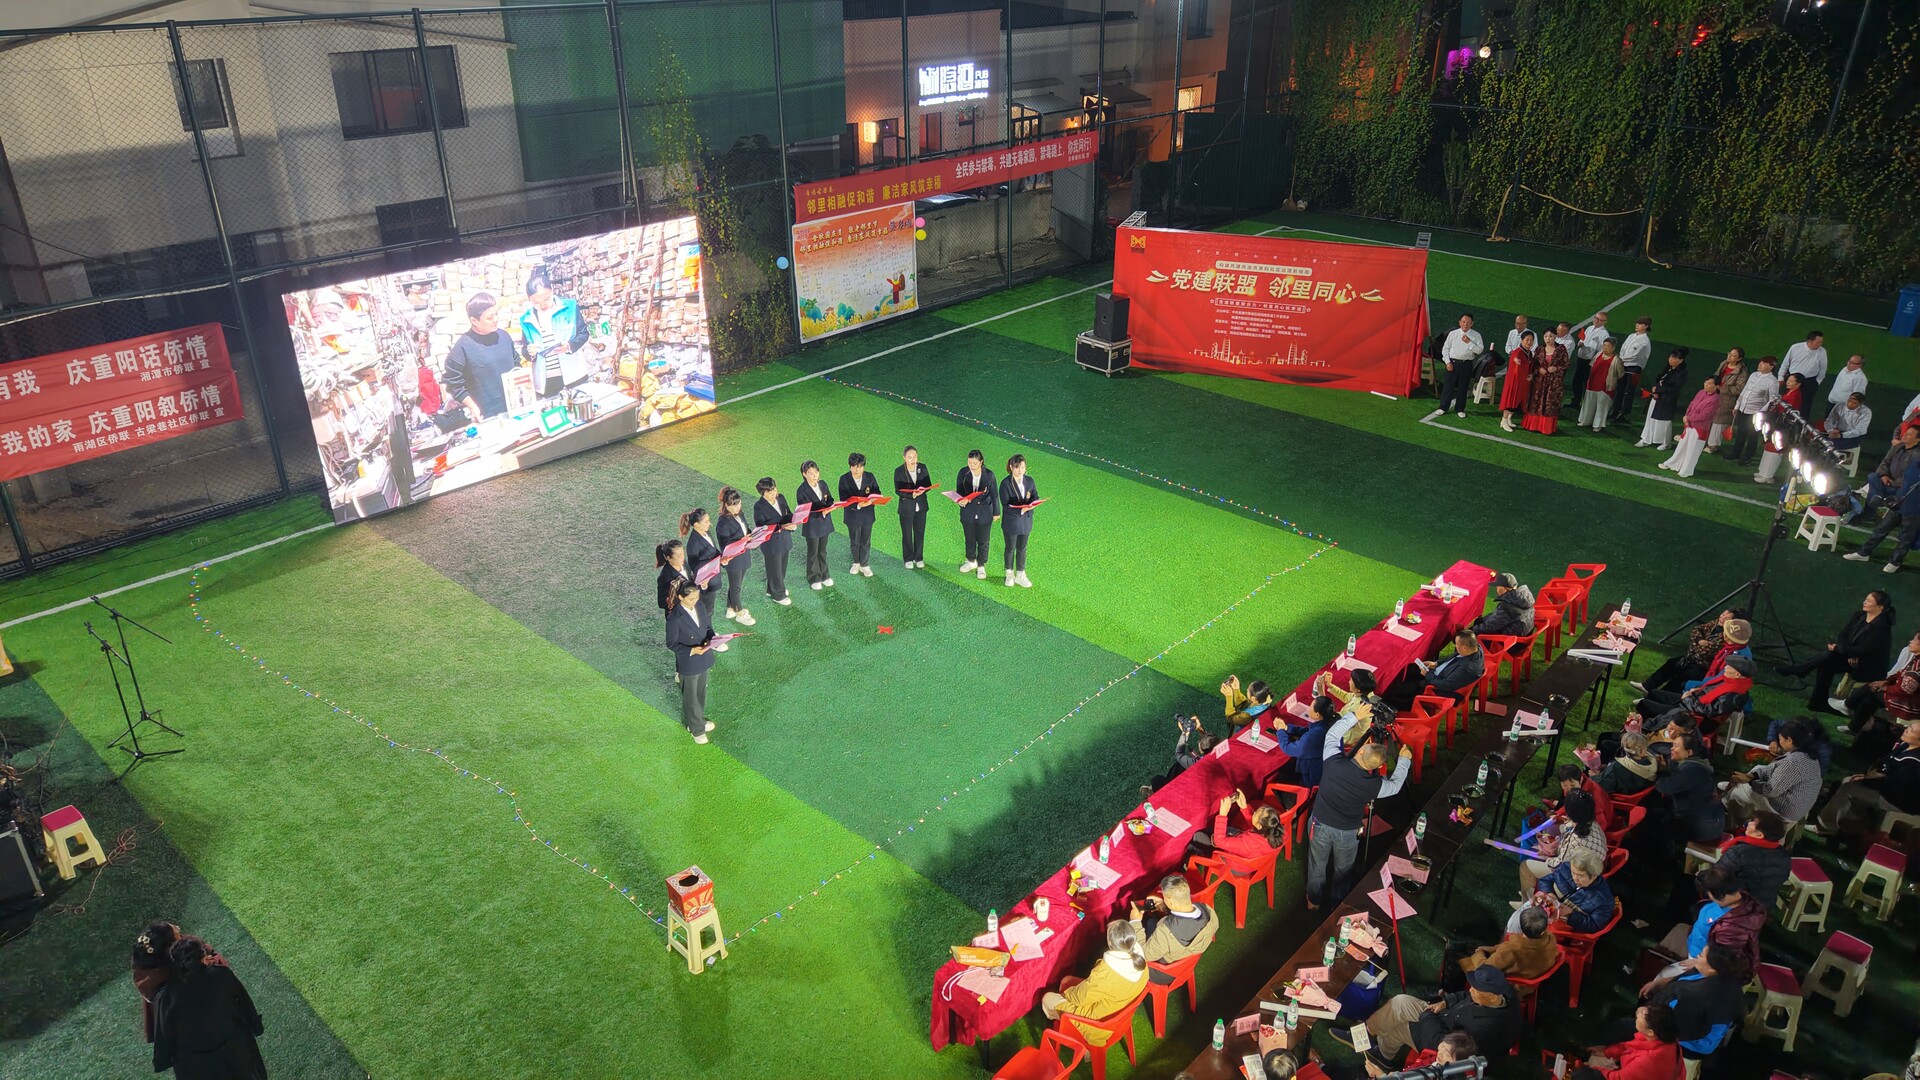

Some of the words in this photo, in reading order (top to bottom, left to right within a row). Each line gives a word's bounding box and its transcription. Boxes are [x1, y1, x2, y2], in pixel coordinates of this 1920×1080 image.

[807, 188, 875, 214] 邻里相融促和谐
[882, 175, 942, 200] 廉洁家风筑幸福
[1170, 268, 1258, 296] 党建联盟
[1268, 276, 1357, 304] 邻里同心
[66, 334, 208, 386] 庆重阳话侨情
[140, 362, 195, 381] 湘潭市侨联
[200, 359, 210, 370] 宣
[0, 419, 77, 456] 我的家
[88, 384, 221, 435] 庆重阳叙侨情
[72, 430, 130, 453] 雨湖区侨联
[215, 407, 224, 417] 宣
